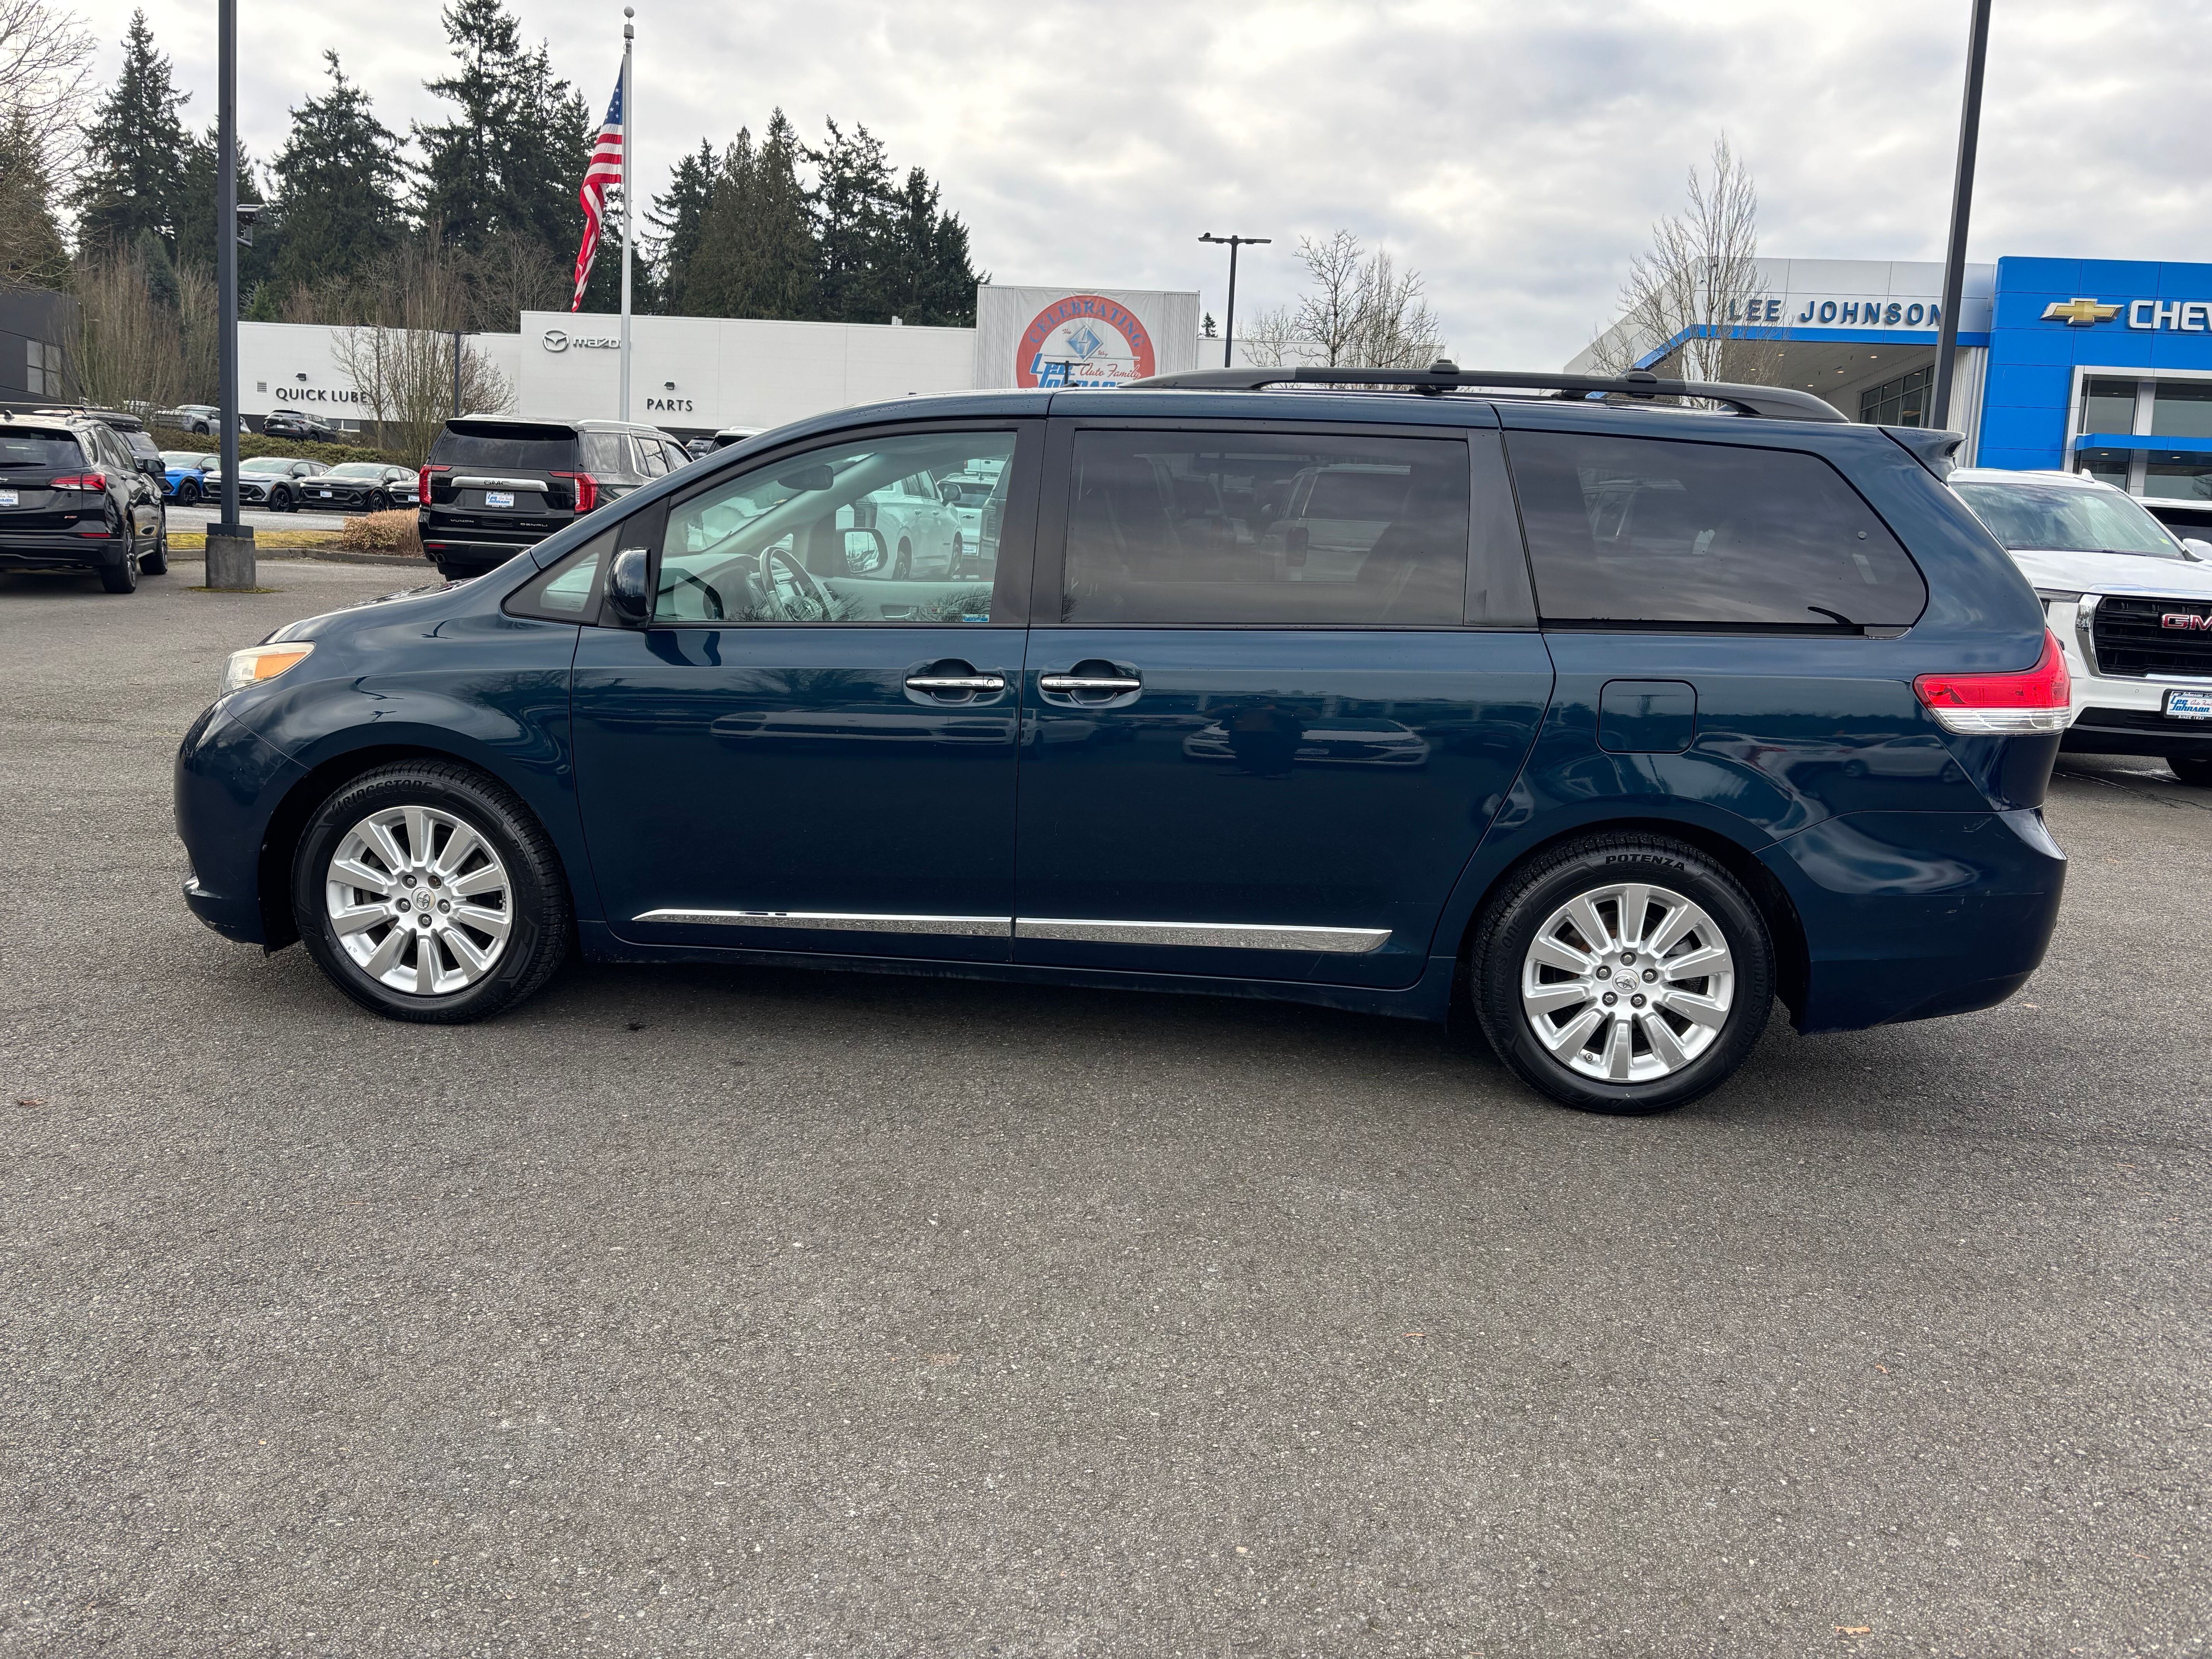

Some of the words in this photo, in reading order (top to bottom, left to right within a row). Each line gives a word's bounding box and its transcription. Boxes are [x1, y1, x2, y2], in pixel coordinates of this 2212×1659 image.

[1728, 299, 1781, 321] LEE
[1801, 301, 1941, 326] JOHNSON
[2128, 300, 2212, 331] CHE
[1029, 301, 1146, 347] CELEBRATING
[573, 337, 621, 349] mazd
[1080, 362, 1105, 376] Auto
[1107, 364, 1142, 380] Family
[276, 388, 327, 402] QUICK
[331, 390, 368, 403] LUBE
[647, 398, 692, 412] PARTS
[2169, 701, 2210, 713] Johnson
[2170, 696, 2188, 704] Lee
[1605, 854, 1685, 871] POTENZA
